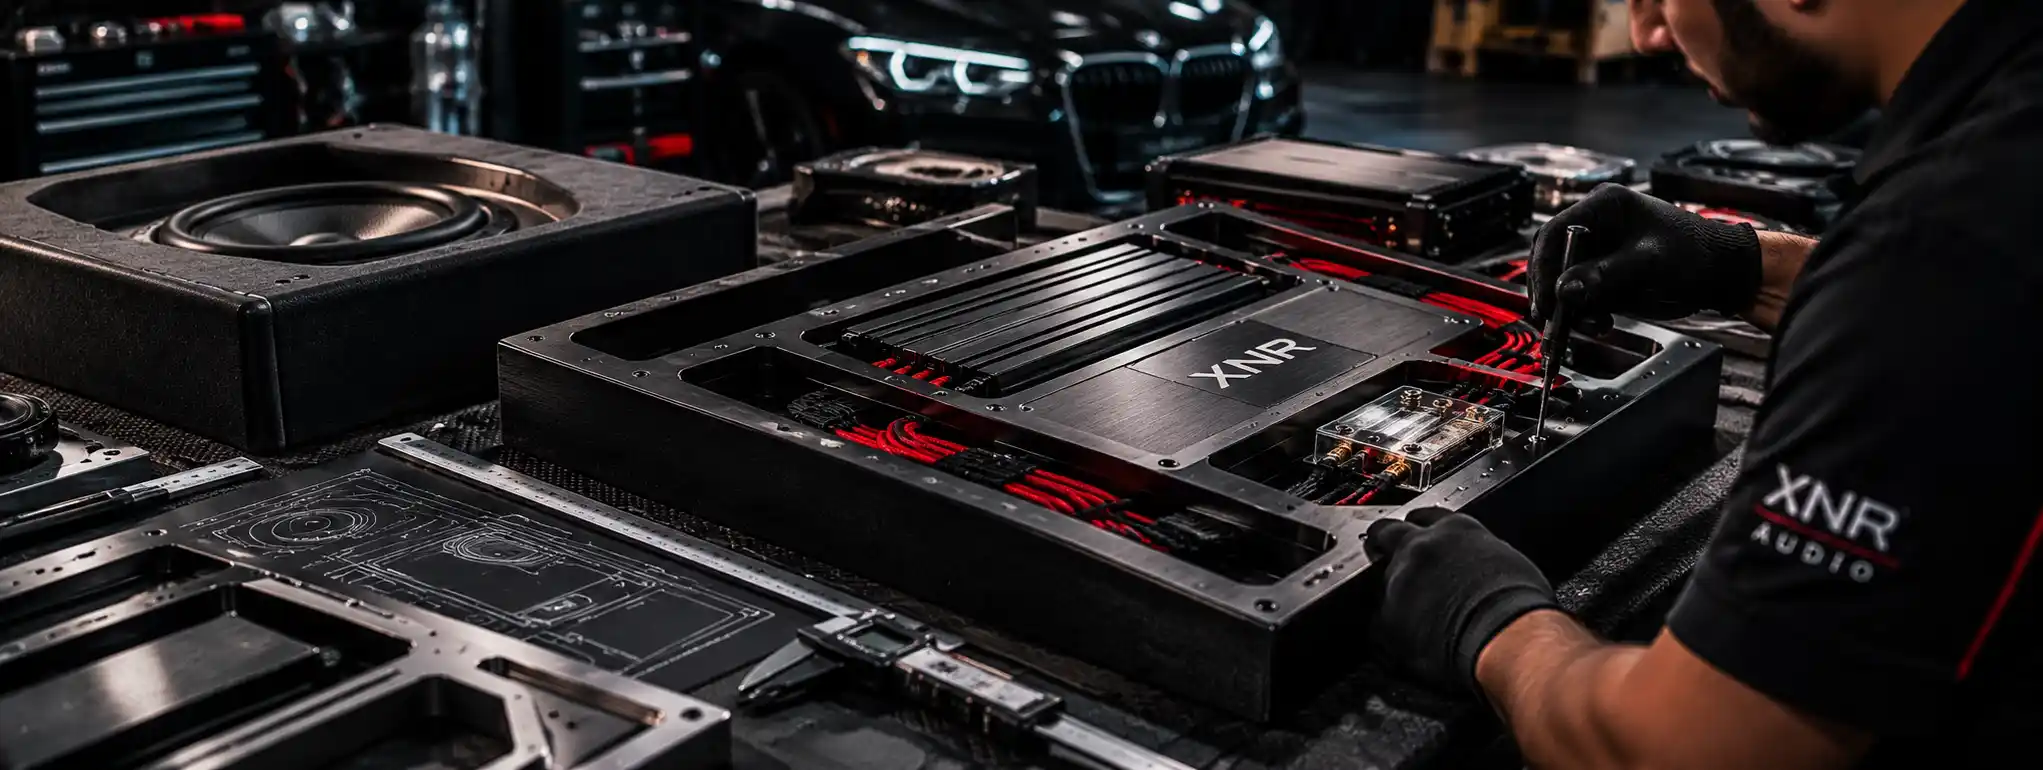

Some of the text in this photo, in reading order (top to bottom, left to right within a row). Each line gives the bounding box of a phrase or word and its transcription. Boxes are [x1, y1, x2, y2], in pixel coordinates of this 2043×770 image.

[1187, 338, 1317, 389] XNR
[1763, 463, 1898, 551] XNR
[1751, 522, 1874, 583] AUDIO
